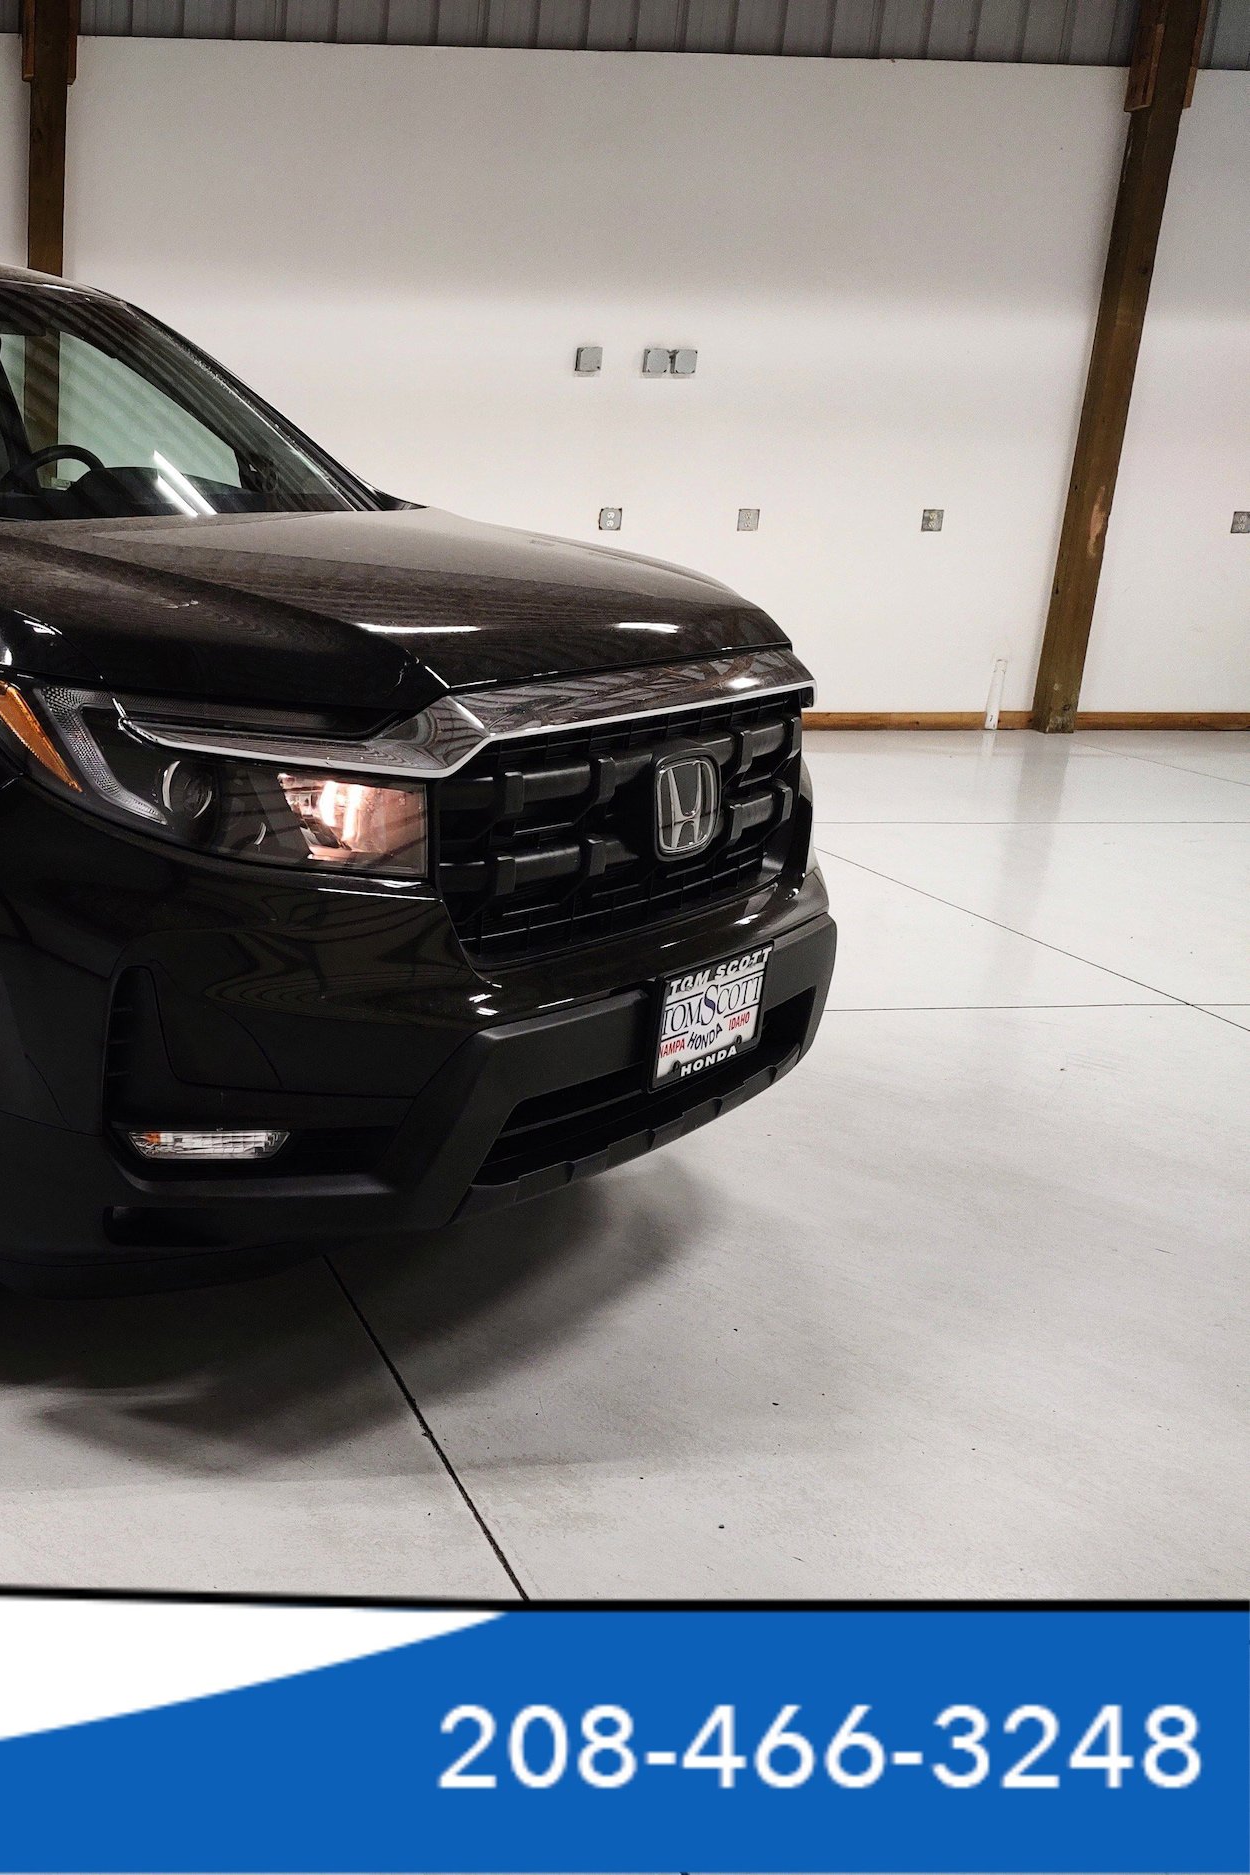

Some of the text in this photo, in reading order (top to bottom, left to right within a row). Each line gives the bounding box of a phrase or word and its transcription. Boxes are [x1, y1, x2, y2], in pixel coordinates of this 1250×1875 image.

[670, 946, 772, 996] TOM SCOTT
[728, 1011, 751, 1031] IDAHO
[658, 1037, 685, 1059] NAMPA
[687, 1023, 723, 1050] HONDA
[680, 1045, 738, 1077] HONDA
